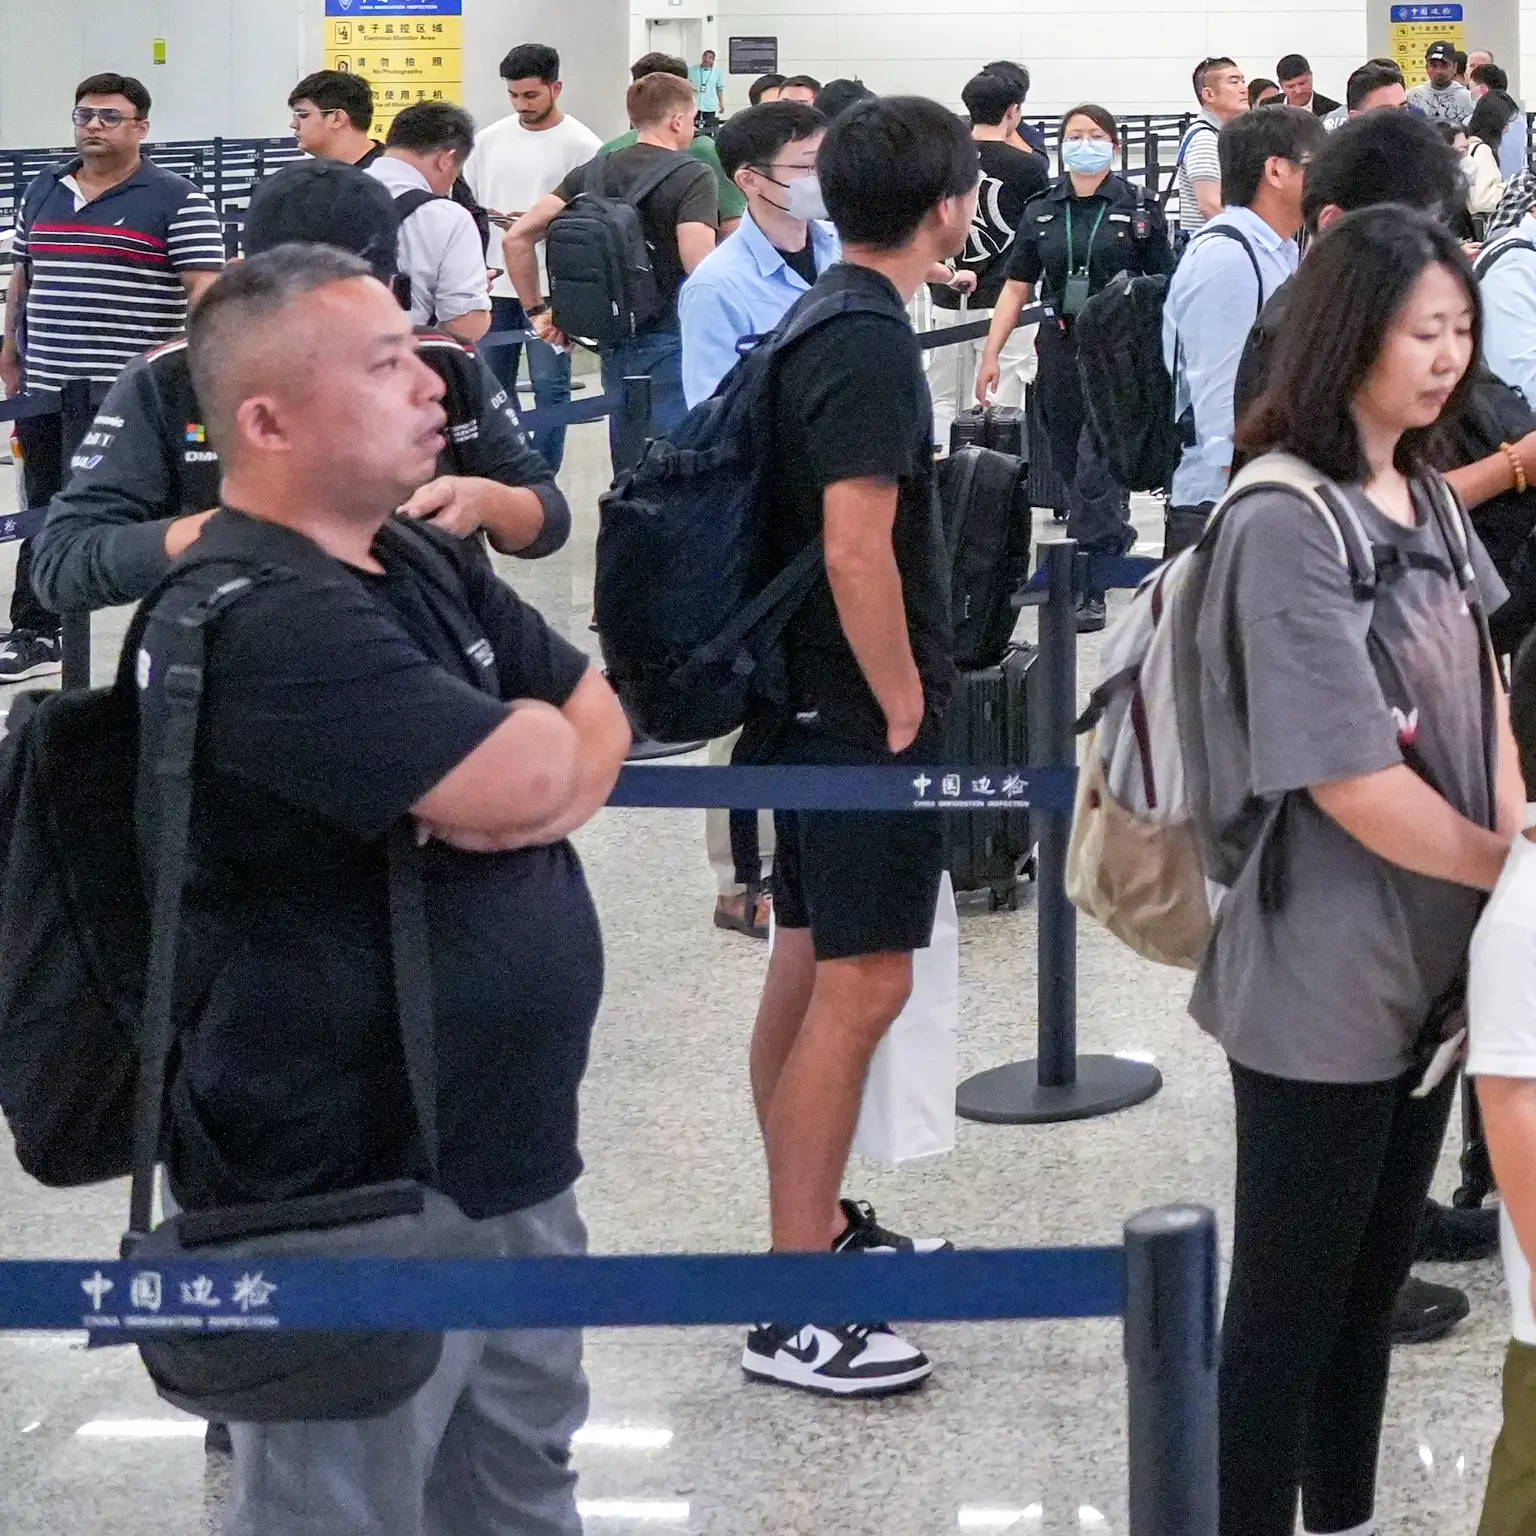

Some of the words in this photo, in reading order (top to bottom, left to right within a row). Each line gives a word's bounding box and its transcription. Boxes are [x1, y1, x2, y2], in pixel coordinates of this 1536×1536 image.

[358, 23, 443, 34] 电子监控区域
[912, 773, 1029, 798] 中国边检
[80, 1269, 279, 1313] 中国边检
